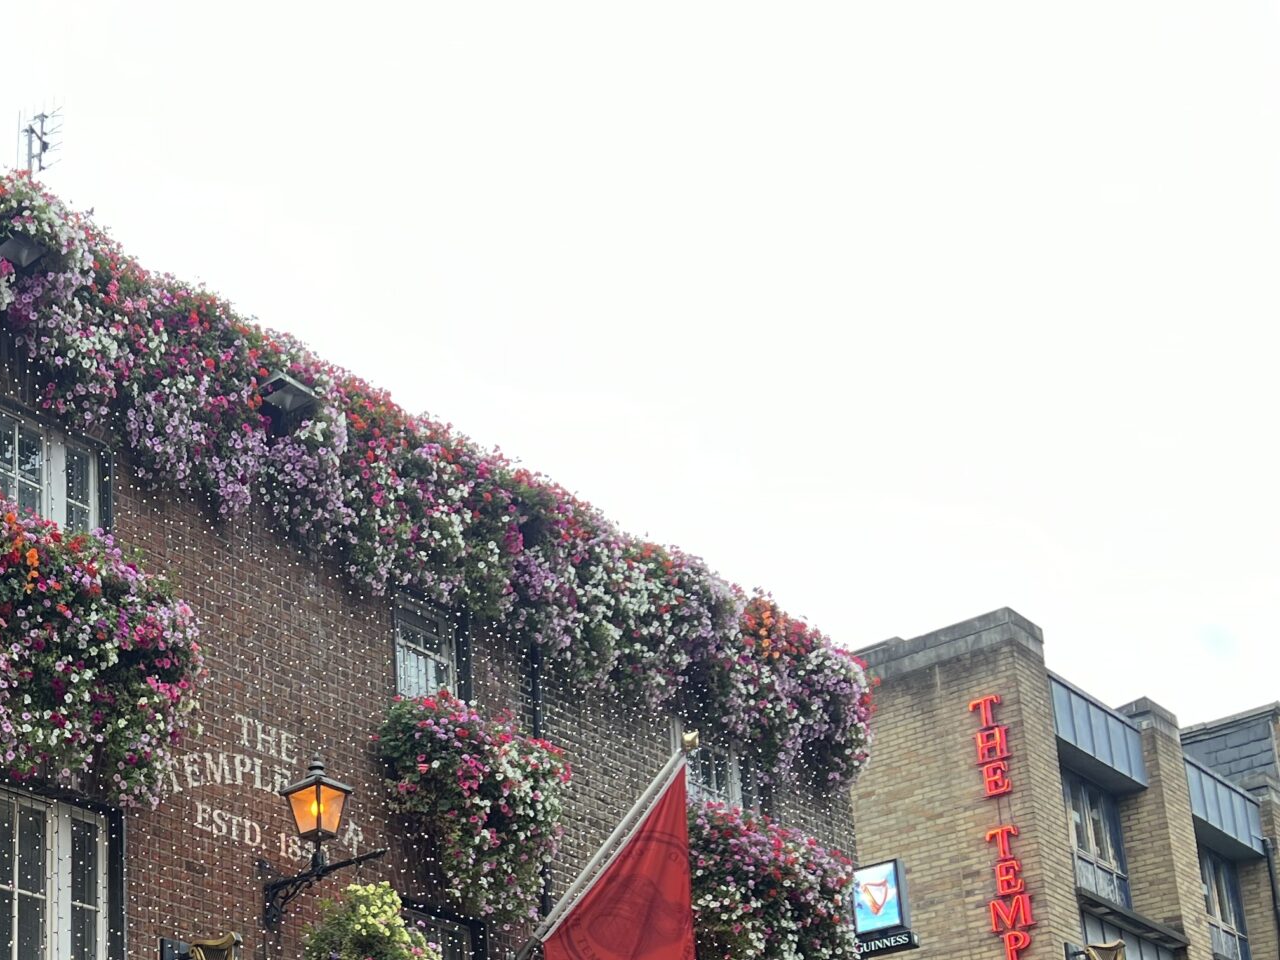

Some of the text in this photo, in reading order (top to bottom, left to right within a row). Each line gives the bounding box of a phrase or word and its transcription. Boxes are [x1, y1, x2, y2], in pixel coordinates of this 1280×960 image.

[235, 713, 297, 764] THE
[968, 694, 1012, 798] THE
[168, 752, 293, 797] TEMPLE
[855, 934, 909, 954] GUINNESS
